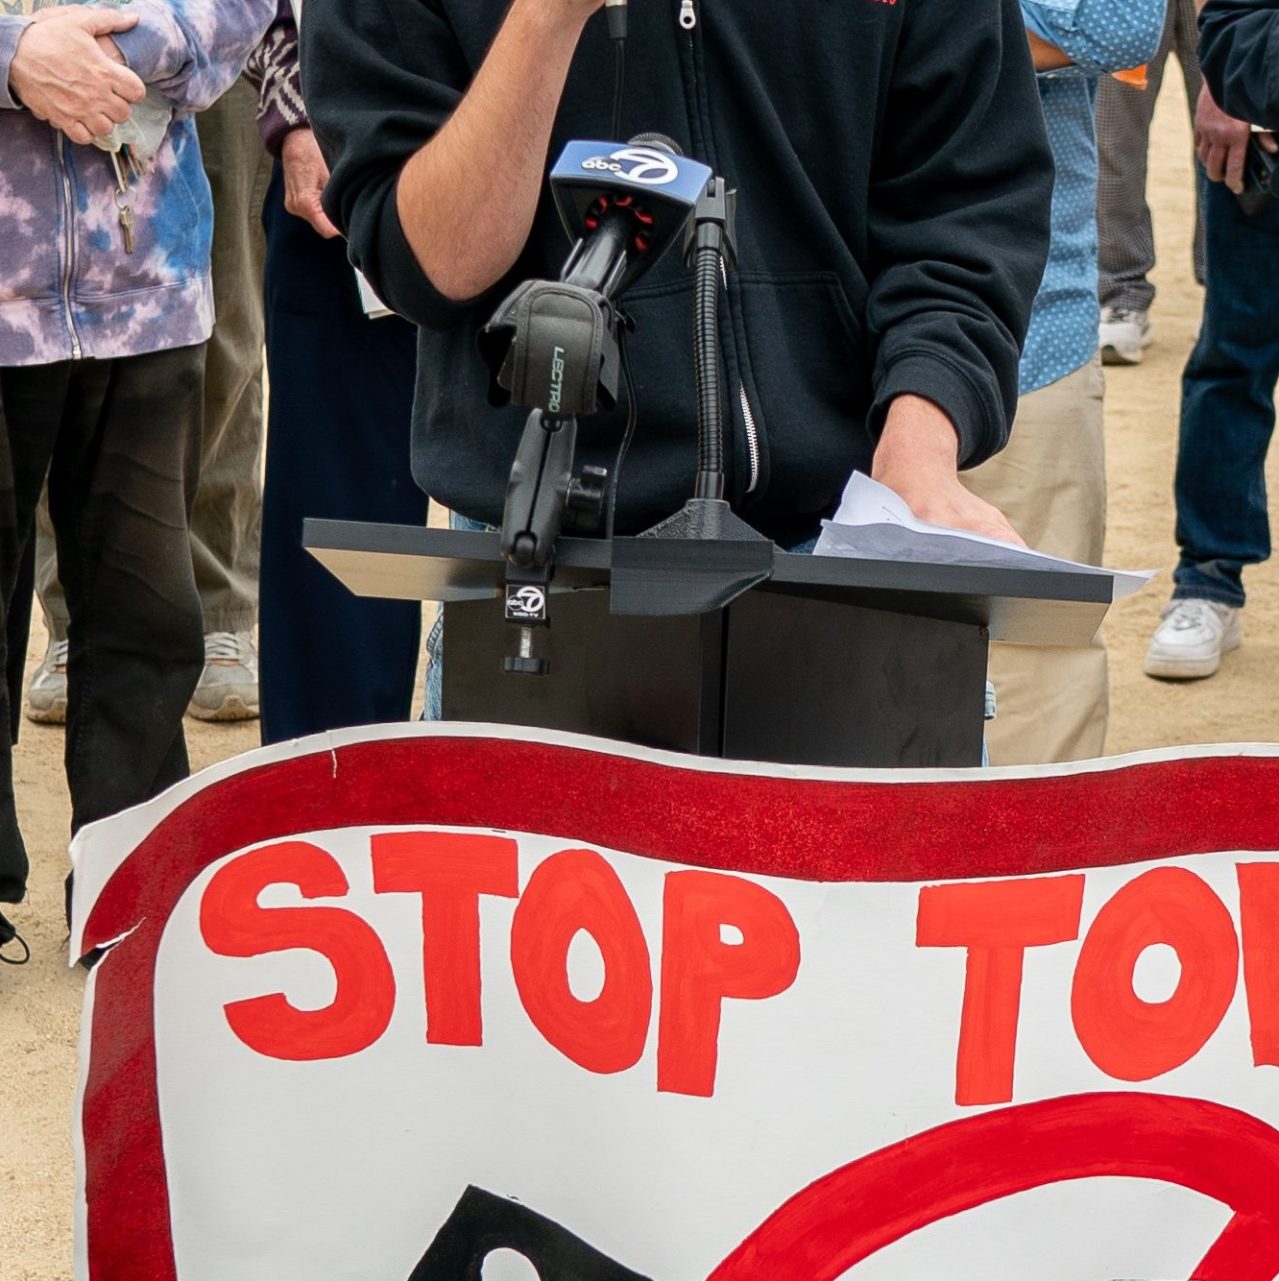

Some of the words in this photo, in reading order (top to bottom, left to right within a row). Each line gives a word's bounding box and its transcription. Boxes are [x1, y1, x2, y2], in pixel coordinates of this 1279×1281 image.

[581, 157, 623, 173] abc
[548, 346, 565, 413] LECTRO
[198, 829, 803, 1098] STOP
